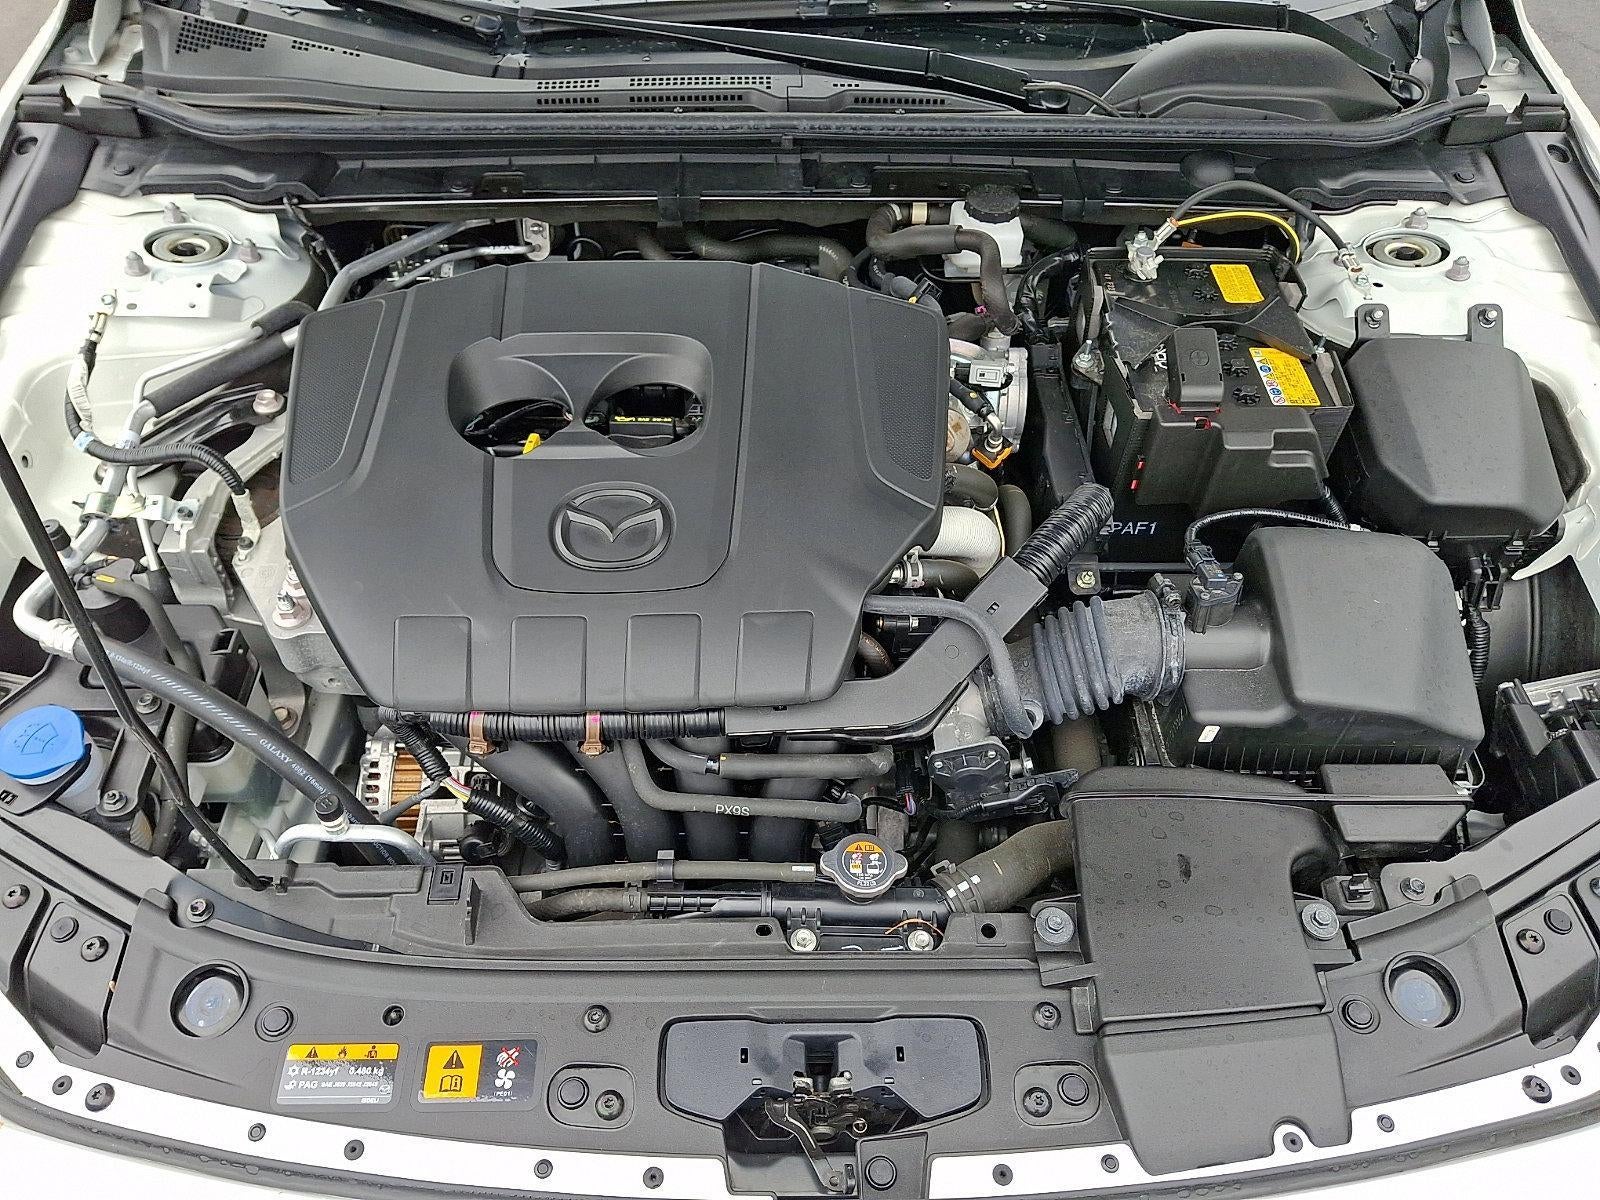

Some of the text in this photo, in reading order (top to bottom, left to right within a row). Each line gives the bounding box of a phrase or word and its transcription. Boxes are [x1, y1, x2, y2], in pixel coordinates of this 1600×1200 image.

[259, 738, 292, 763] GALAXY
[715, 804, 750, 816] PX9S
[298, 1081, 318, 1090] PAG
